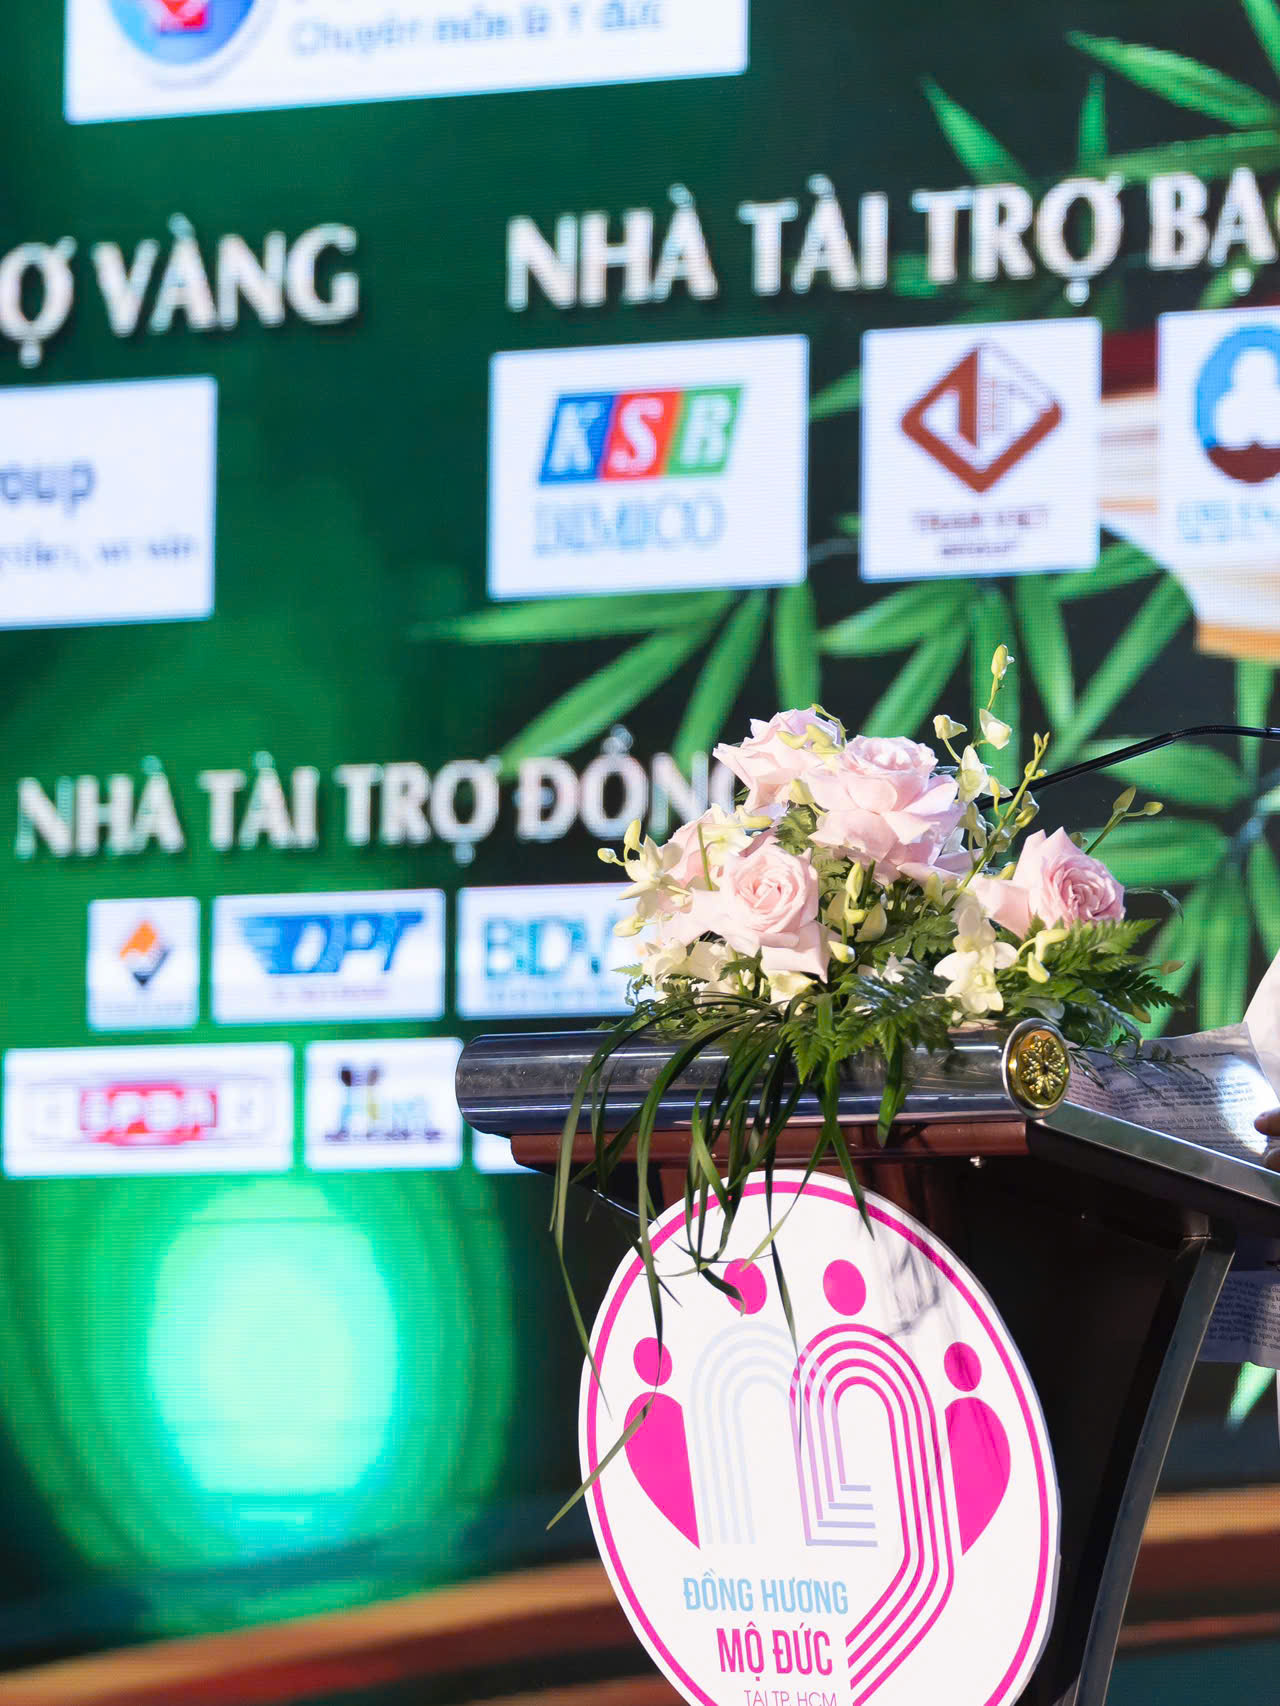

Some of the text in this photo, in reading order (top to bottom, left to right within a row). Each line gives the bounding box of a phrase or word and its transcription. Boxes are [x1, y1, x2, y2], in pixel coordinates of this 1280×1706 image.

[92, 213, 359, 337] VÀNG
[506, 183, 717, 311] NHÀ
[739, 174, 889, 294] TÀI
[912, 172, 1124, 306] TRỢ
[15, 755, 184, 860] NHÀ
[199, 750, 320, 852] TÀI
[334, 755, 502, 866] TRỢ
[683, 1568, 849, 1614] ĐỒNG HƯƠNG
[716, 1621, 832, 1681] MỘ ĐỨC
[796, 1691, 837, 1706] HCM
